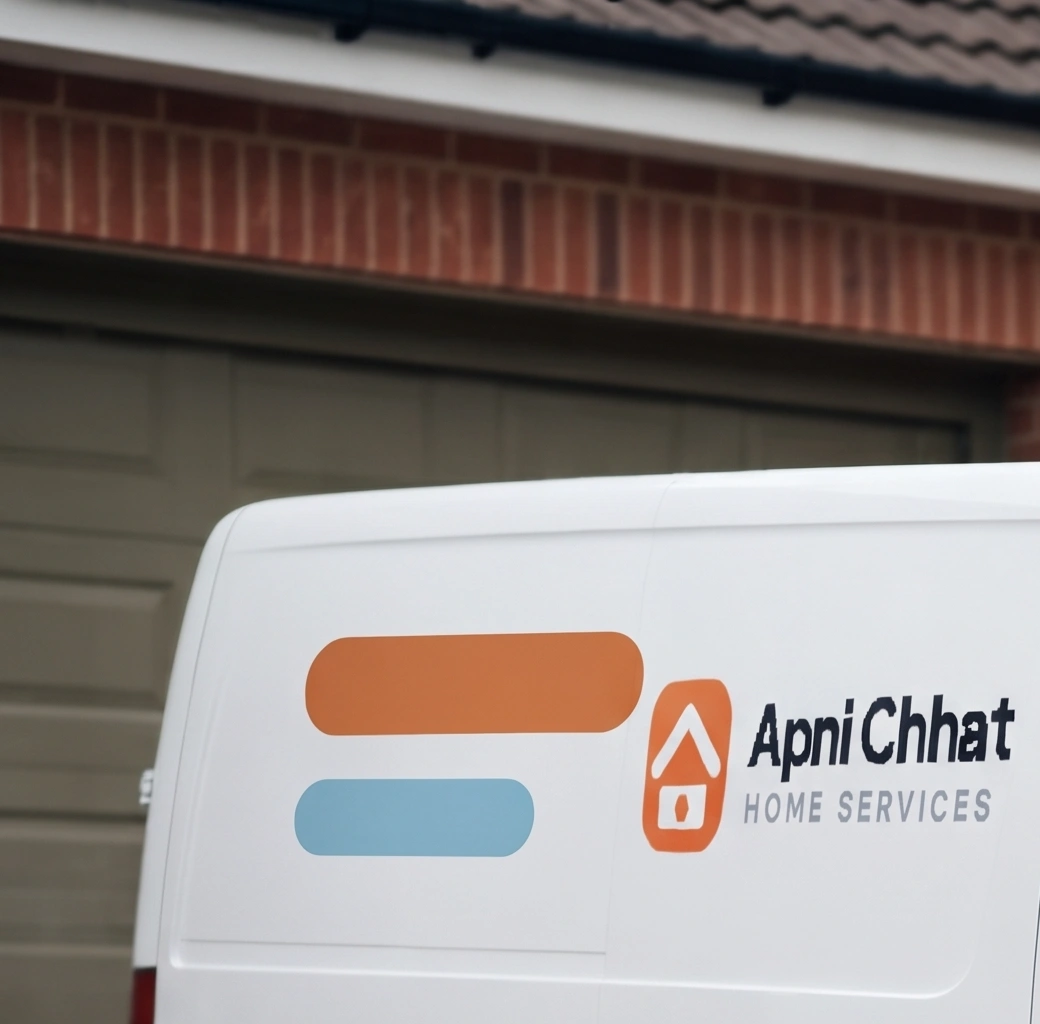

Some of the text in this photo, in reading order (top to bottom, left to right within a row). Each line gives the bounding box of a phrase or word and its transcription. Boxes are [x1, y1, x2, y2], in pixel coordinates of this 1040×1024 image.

[747, 693, 1016, 784] Apni Chhat
[743, 788, 992, 825] HOME SERVICES
